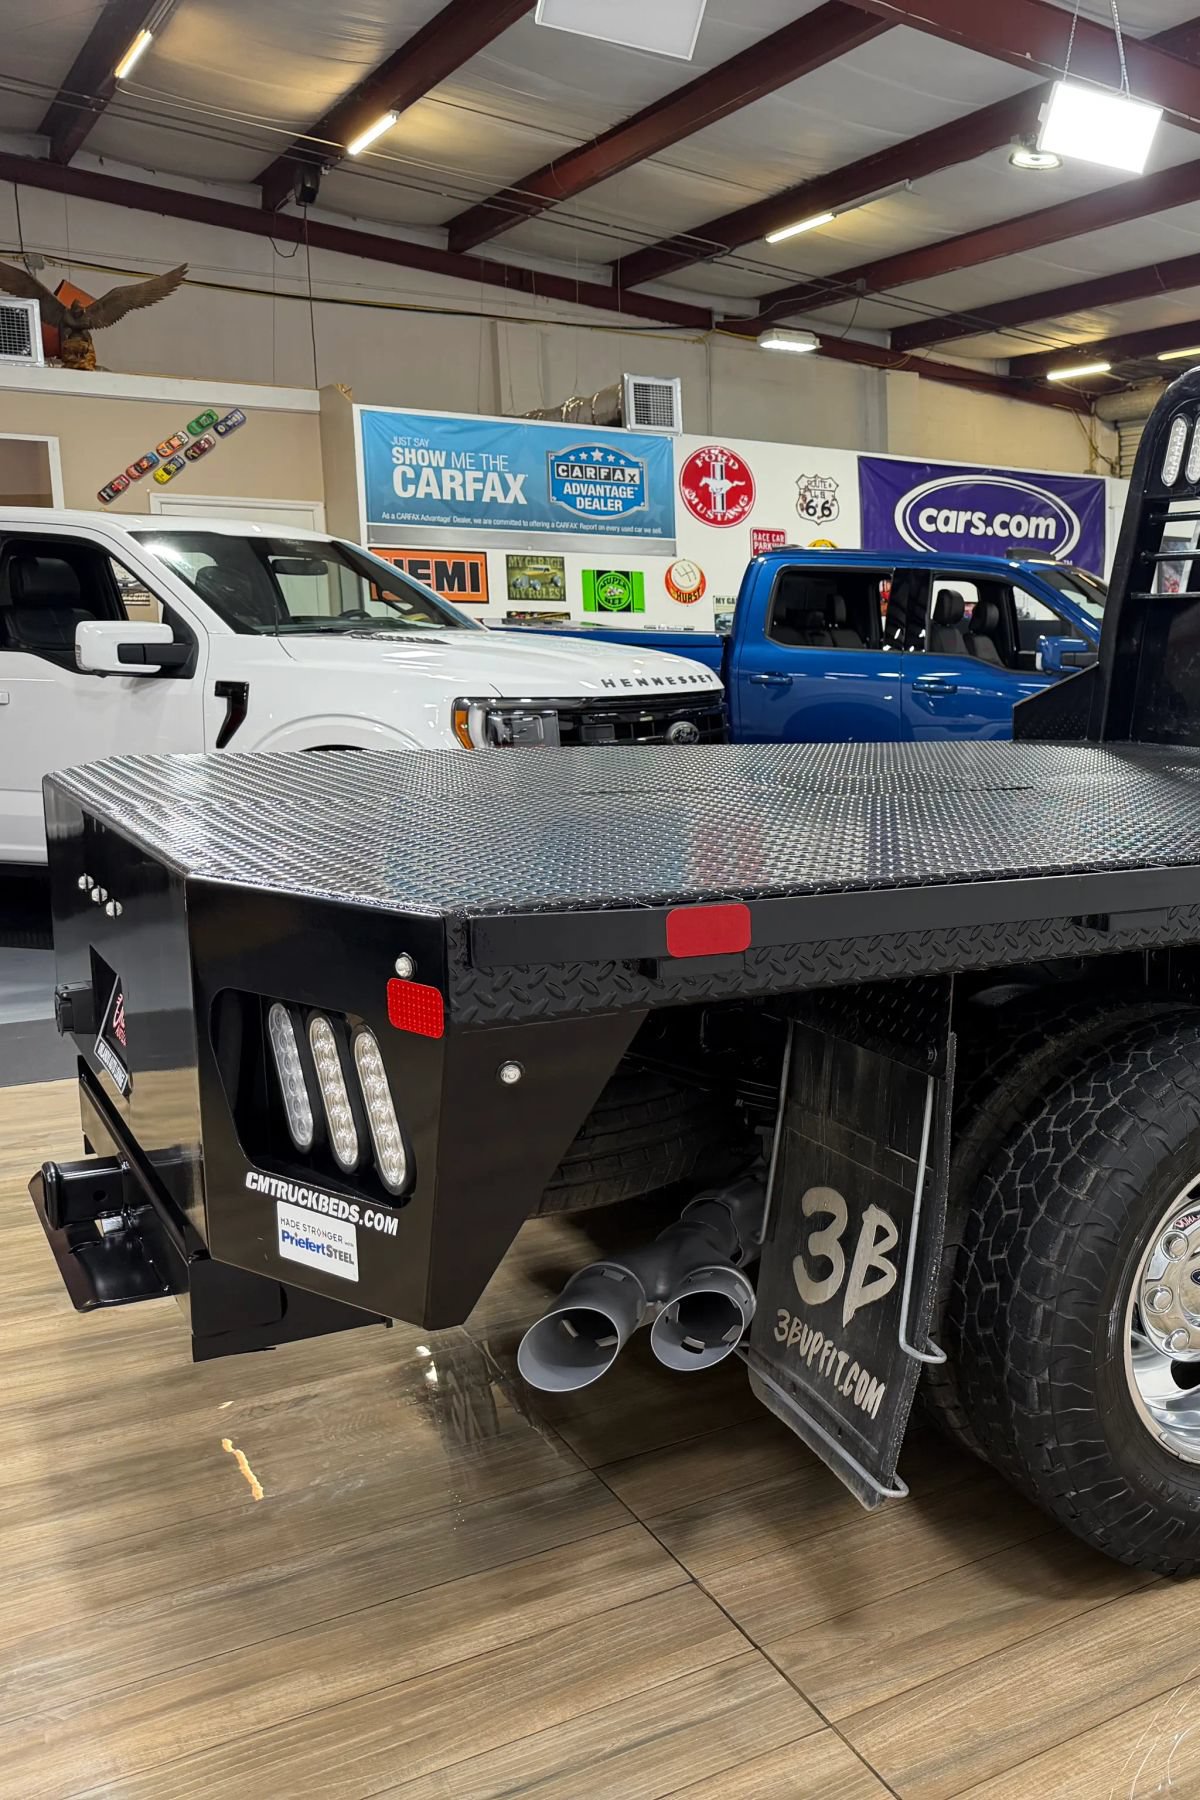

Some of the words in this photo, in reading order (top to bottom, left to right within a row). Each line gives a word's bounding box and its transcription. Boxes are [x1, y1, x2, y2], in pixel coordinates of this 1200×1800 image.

[391, 436, 412, 447] JUST
[414, 438, 430, 448] SAY
[392, 447, 446, 467] SHOW
[451, 452, 475, 470] ME
[479, 453, 509, 472] THE
[694, 452, 739, 470] FORD
[558, 465, 638, 484] CARFAX
[393, 465, 528, 505] CARFAX
[563, 482, 635, 499] ADVANTAGE
[807, 479, 828, 490] ROUTE
[576, 497, 623, 512] DEALER
[685, 486, 749, 521] MUSTANG
[806, 499, 832, 519] 66
[396, 512, 420, 521] CARFAX
[452, 515, 473, 525] Dealer,
[493, 519, 522, 527] committed
[529, 520, 550, 529] offering
[556, 521, 577, 530] CARFAX
[580, 522, 597, 532] Report
[606, 525, 620, 533] every
[621, 525, 634, 533] used
[918, 507, 1057, 540] cars.com
[753, 532, 770, 542] RACE
[771, 533, 784, 543] CAR
[508, 555, 524, 568] MY
[525, 556, 563, 569] GARAGE
[600, 576, 627, 588] SUPER
[510, 587, 526, 599] MY
[528, 587, 564, 600] RULES!
[676, 590, 701, 603] HURST
[715, 596, 725, 604] MY
[600, 674, 713, 688] HENNESSEY
[245, 1171, 399, 1236] CMTRUCKBEDS.COM
[280, 1216, 301, 1231] MADE
[302, 1223, 343, 1243] STRONGER
[793, 1186, 898, 1328] 3B
[774, 1308, 886, 1420] 3BUPFIT.COM
